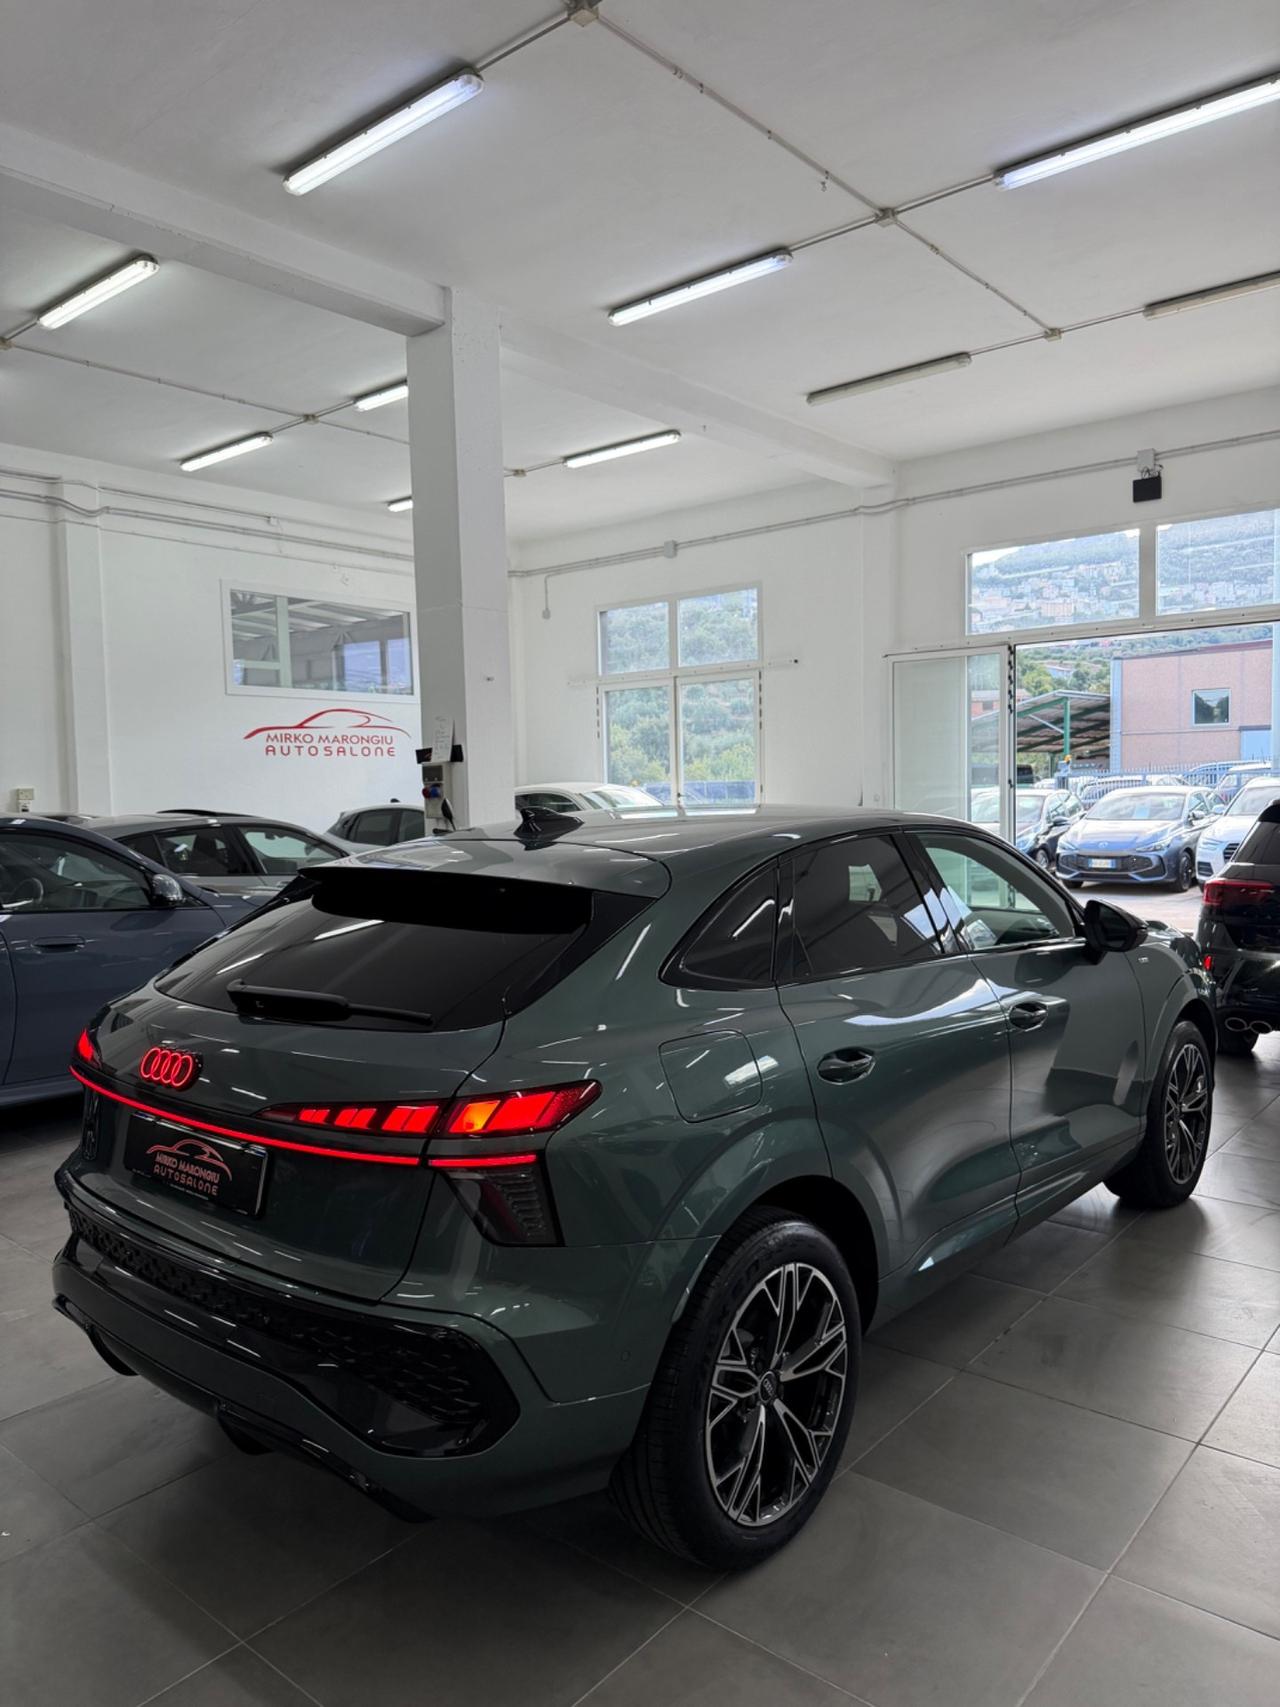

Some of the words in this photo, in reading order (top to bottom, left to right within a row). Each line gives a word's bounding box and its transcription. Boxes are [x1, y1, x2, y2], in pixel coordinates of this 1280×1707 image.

[265, 733, 314, 744] MIRKO
[317, 735, 394, 745] MARONGIU
[265, 744, 396, 757] AUTOSALONE
[155, 1152, 179, 1168] MIRKO
[179, 1159, 220, 1183] MARONGIU
[153, 1164, 219, 1196] AUTOSALONE
